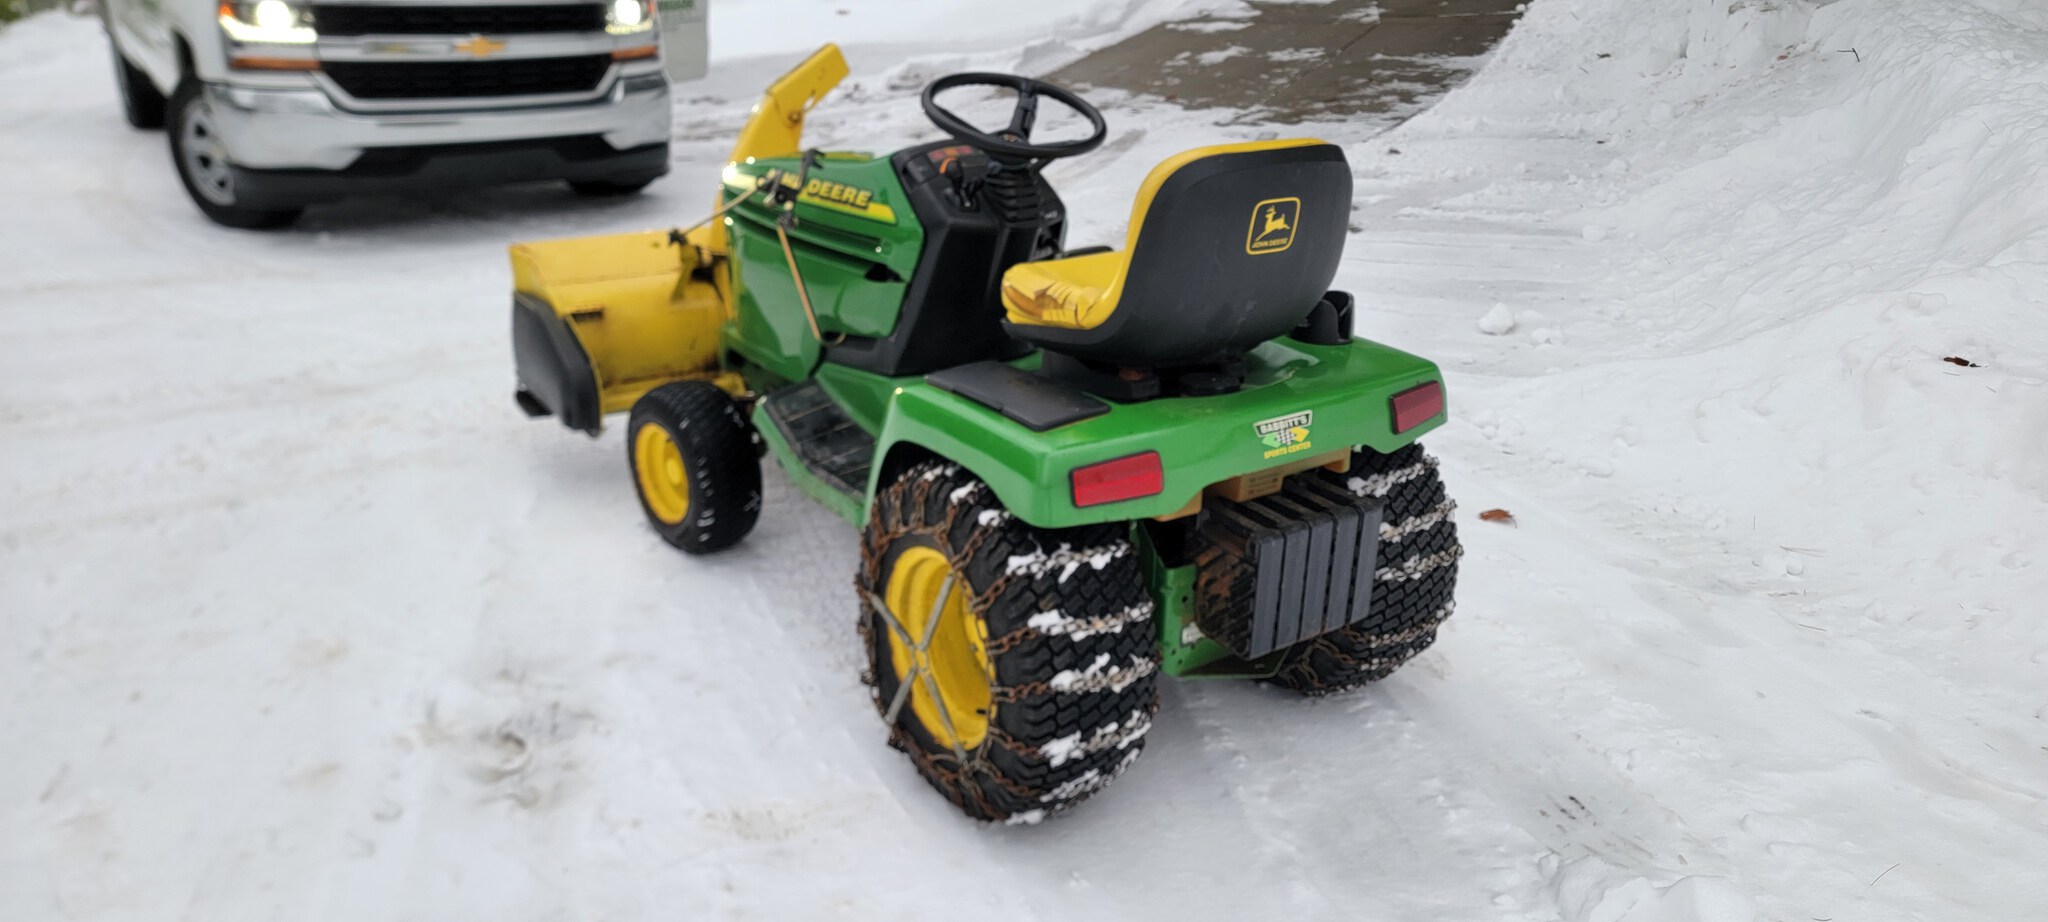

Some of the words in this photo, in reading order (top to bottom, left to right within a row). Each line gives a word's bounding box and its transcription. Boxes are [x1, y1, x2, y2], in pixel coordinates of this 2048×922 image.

[808, 178, 872, 208] DEERE
[1263, 447, 1287, 459] SPORTS
[1288, 441, 1311, 453] CENTER
